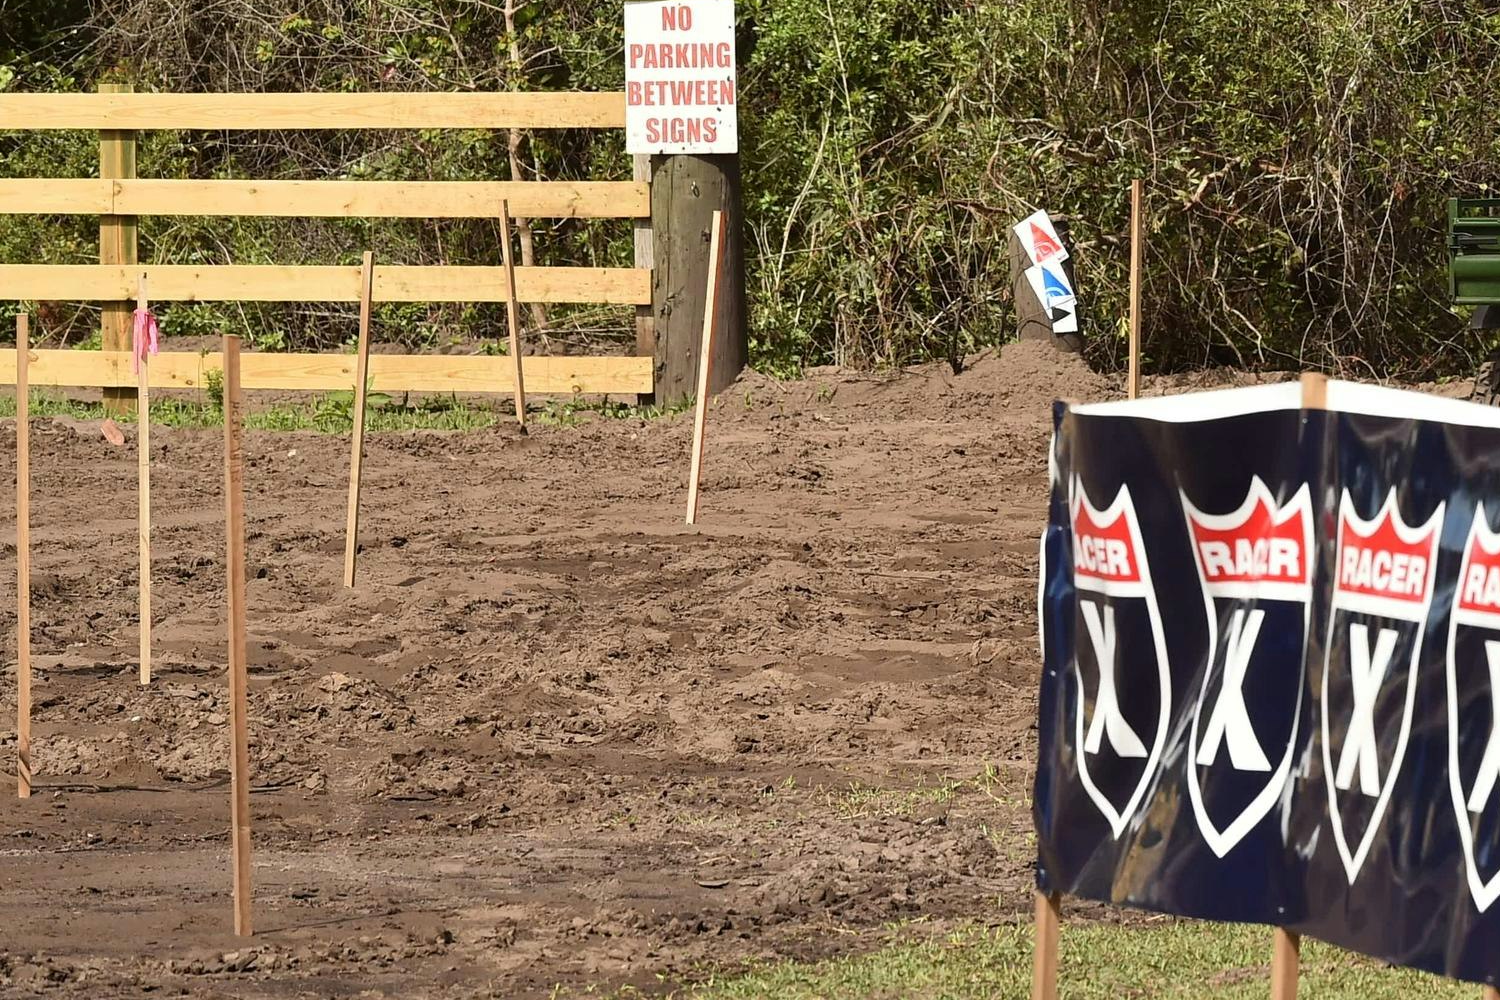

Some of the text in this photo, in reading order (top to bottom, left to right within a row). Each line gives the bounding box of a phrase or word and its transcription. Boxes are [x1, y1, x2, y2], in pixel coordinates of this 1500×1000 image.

[660, 5, 693, 31] NO
[629, 42, 731, 69] PARKING
[627, 79, 734, 106] BETWEEN
[645, 117, 717, 143] SIGNS
[1075, 533, 1132, 576] ACER
[1342, 545, 1427, 597] RACER
[1080, 599, 1147, 758] X
[1197, 609, 1272, 772] X
[1335, 623, 1398, 798] X
